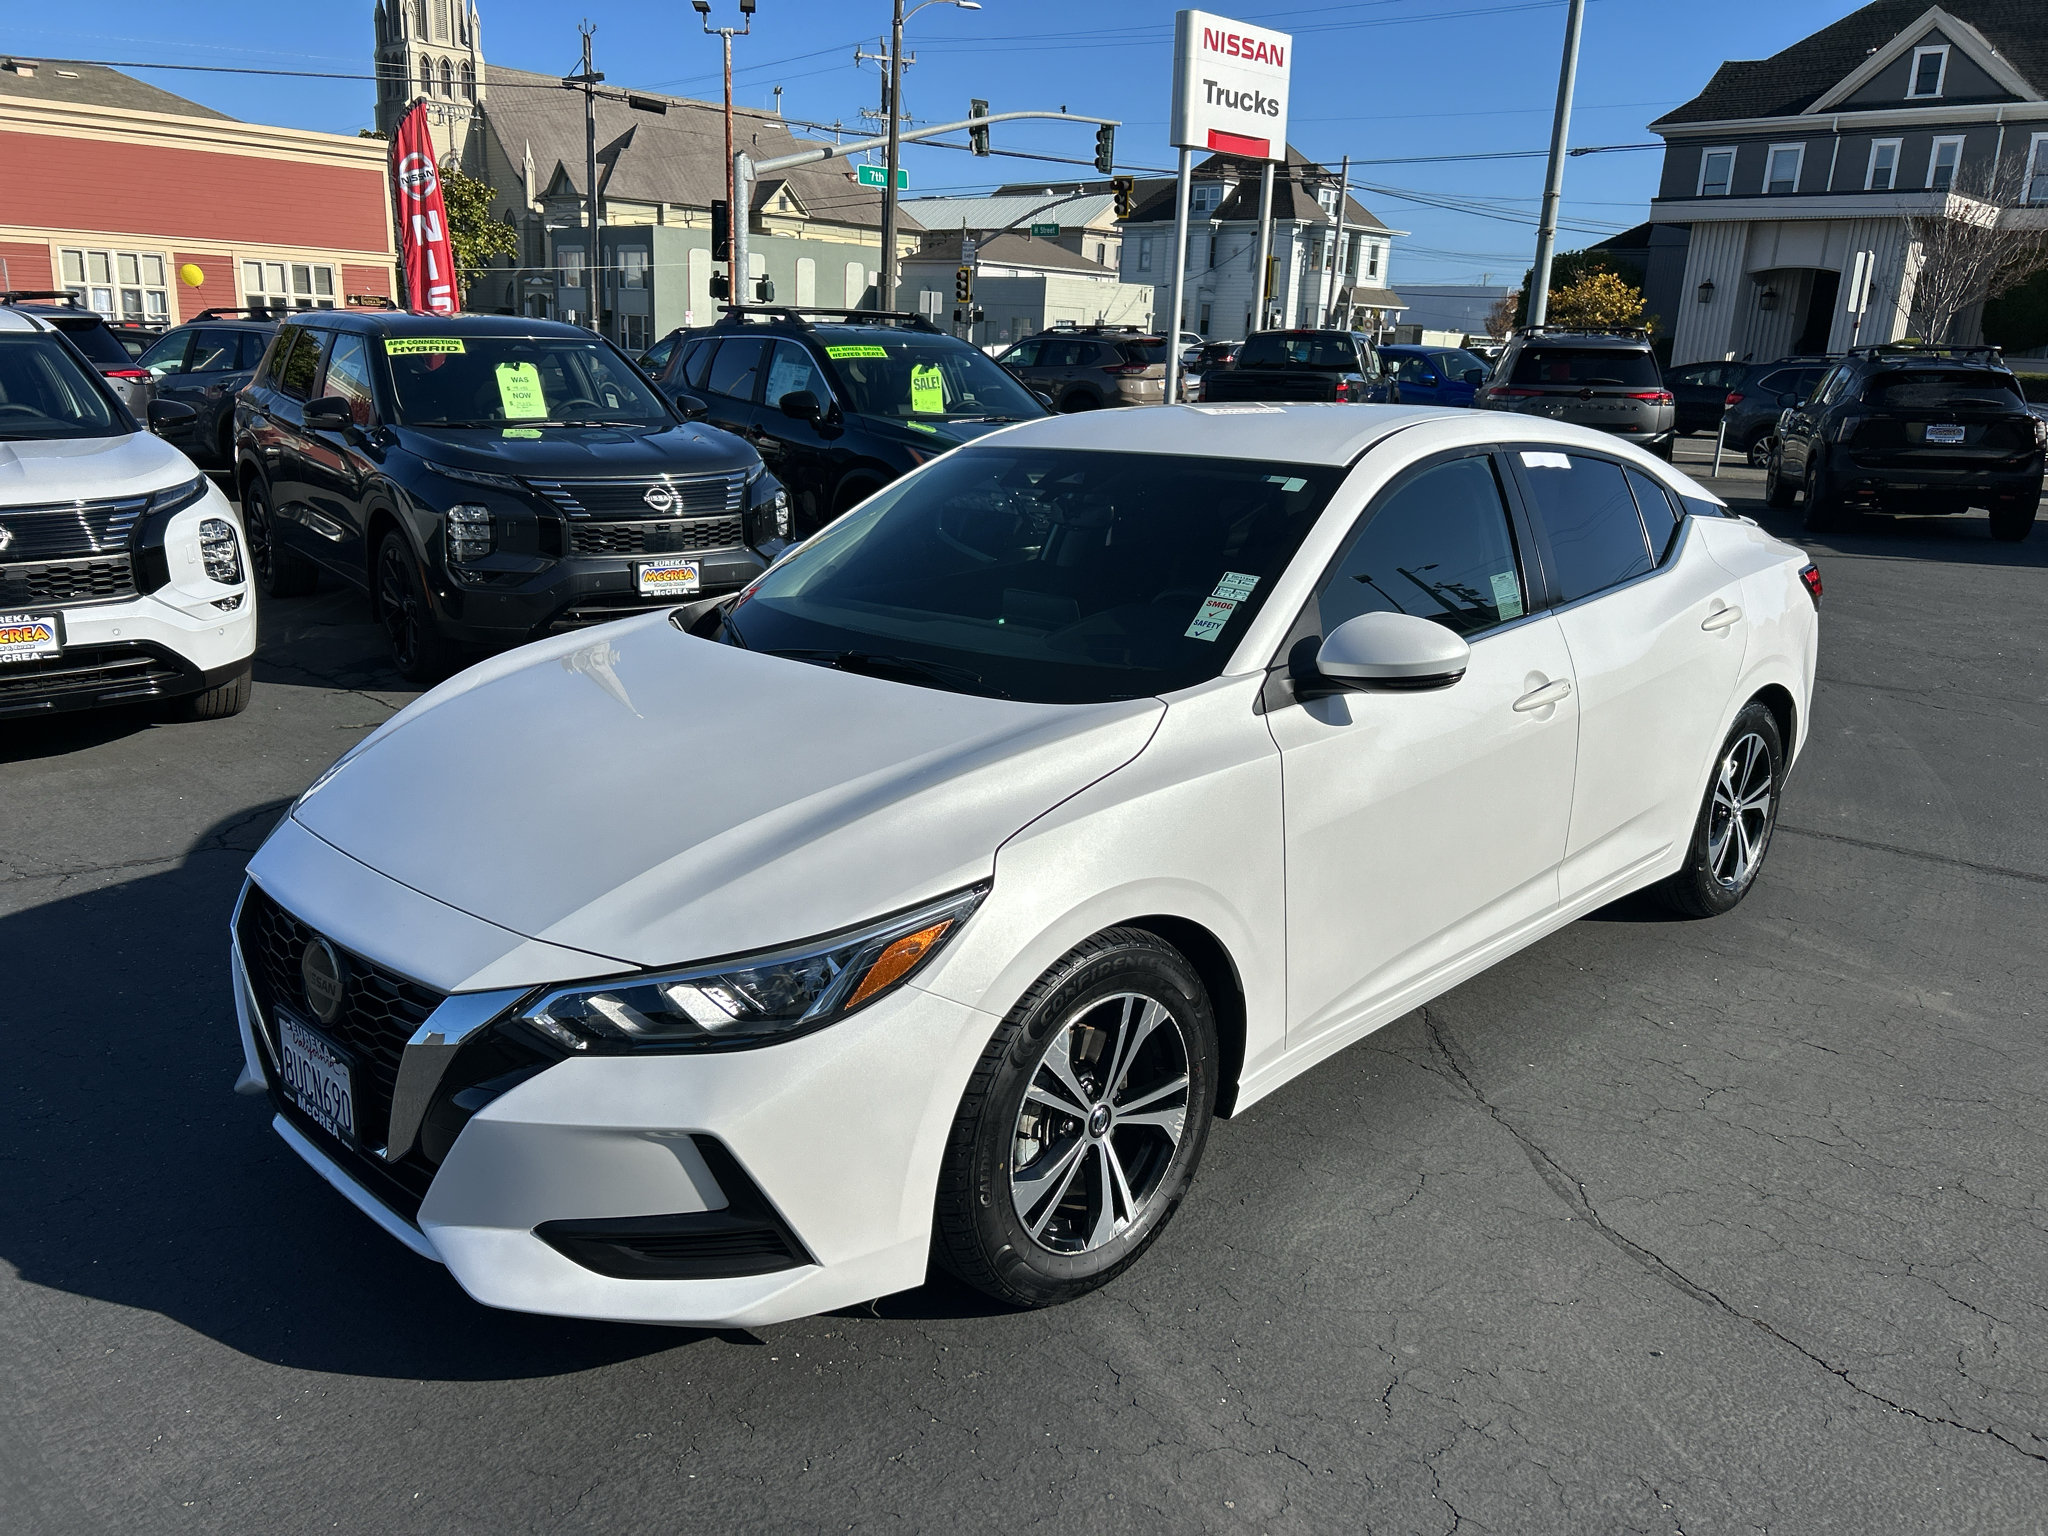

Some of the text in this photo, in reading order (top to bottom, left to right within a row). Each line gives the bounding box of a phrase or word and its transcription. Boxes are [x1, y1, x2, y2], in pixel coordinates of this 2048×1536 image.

[1203, 27, 1284, 67] NISSAN
[1203, 78, 1280, 117] Trucks
[869, 170, 885, 183] 7th
[1040, 226, 1056, 234] Street
[913, 376, 941, 391] SALE!
[644, 569, 694, 582] McCREA
[653, 588, 688, 596] McCREA
[1206, 600, 1234, 610] SMOG
[1193, 619, 1222, 630] SAFETY
[0, 652, 40, 661] CREA
[290, 1020, 332, 1061] EUREKA
[284, 1045, 352, 1133] 8UCN690
[297, 1093, 341, 1140] McCREA
